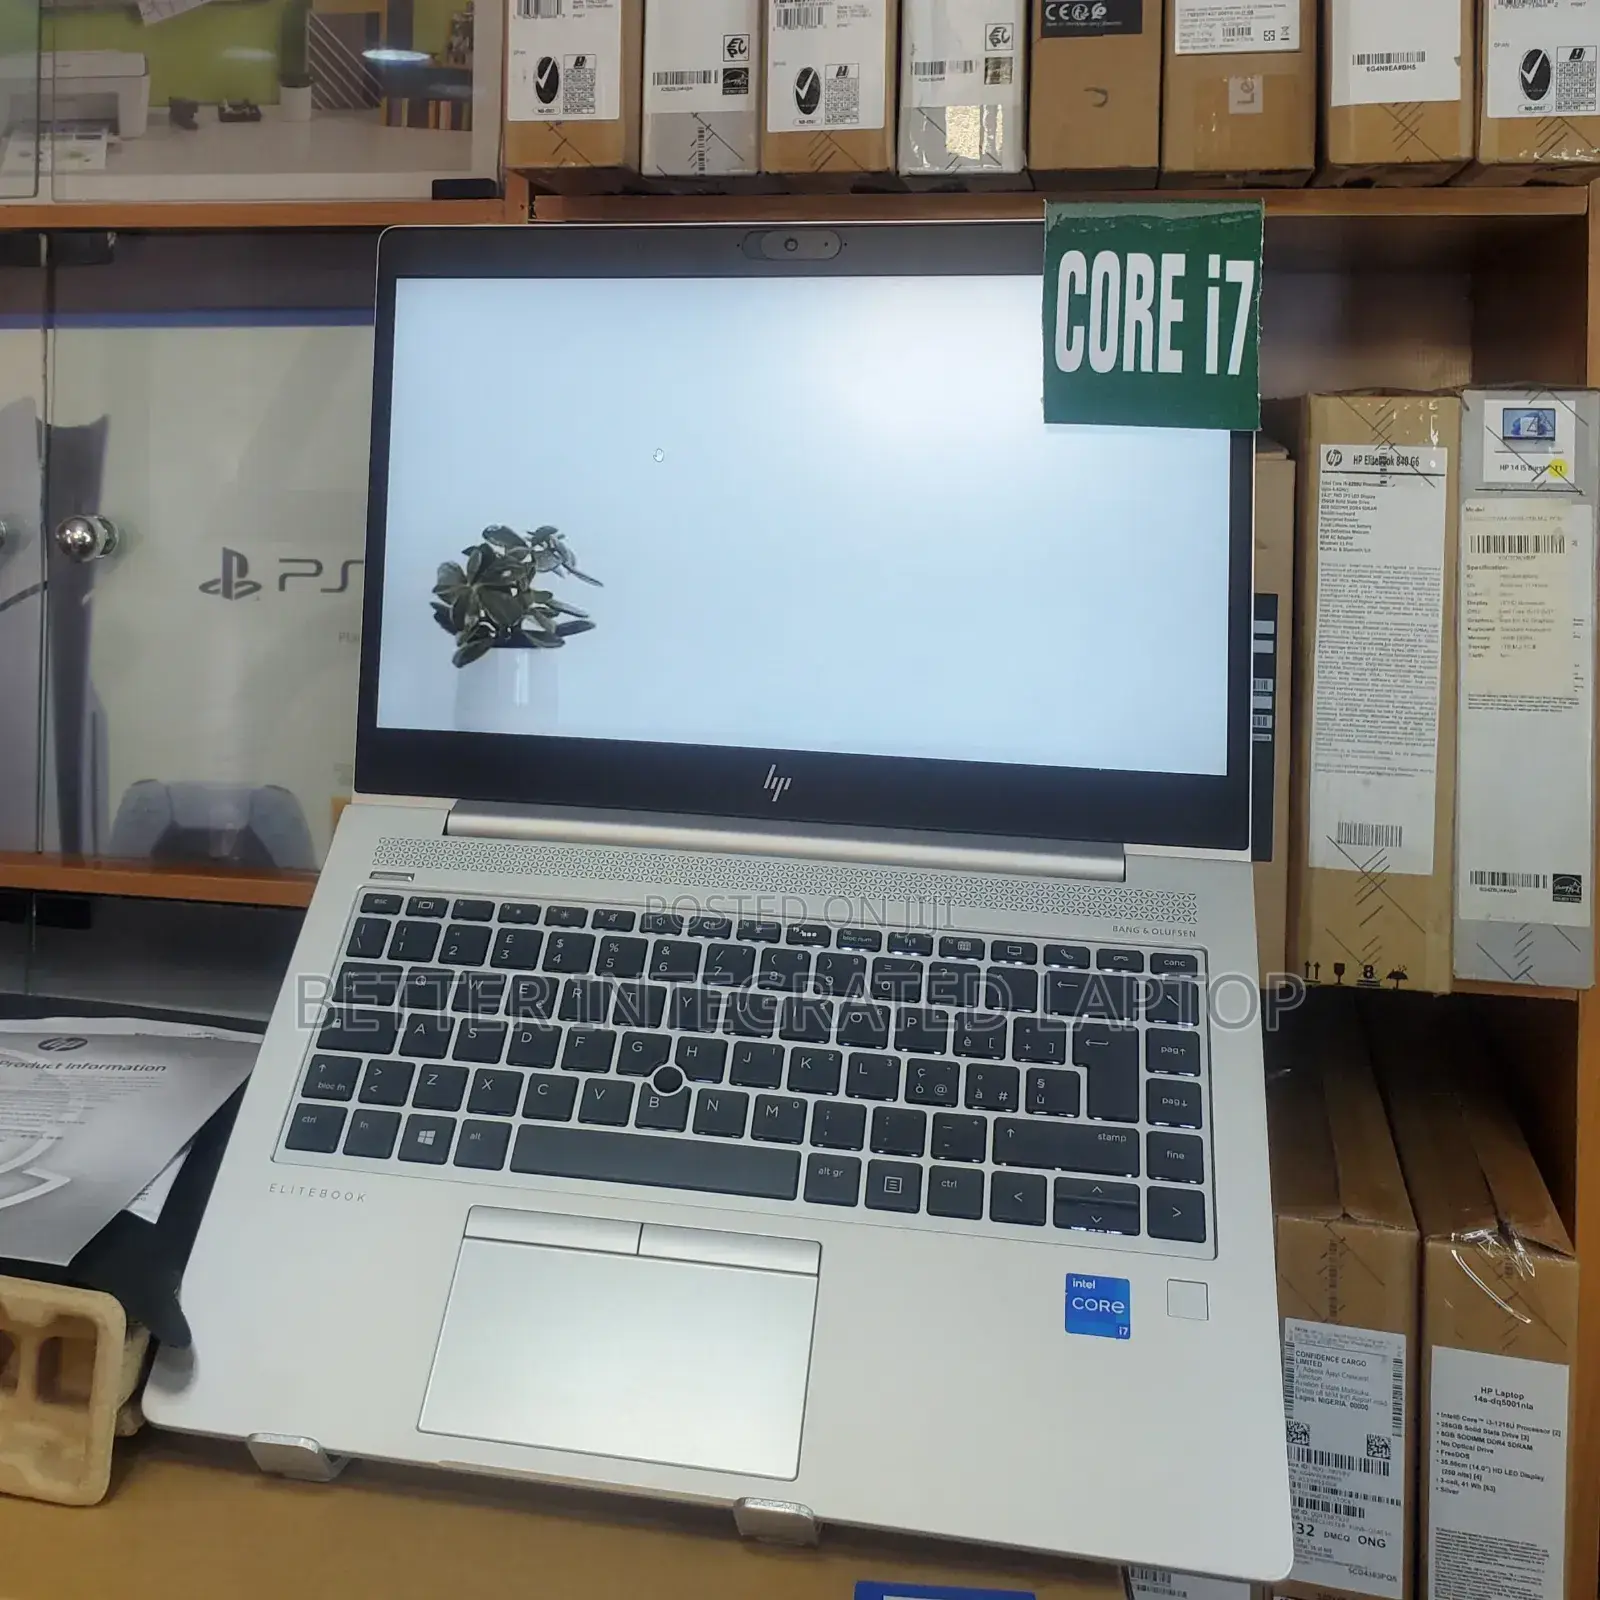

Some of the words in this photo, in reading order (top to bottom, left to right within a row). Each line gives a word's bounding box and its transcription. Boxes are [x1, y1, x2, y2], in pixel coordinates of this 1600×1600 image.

[1054, 250, 1186, 374] CORE
[1205, 254, 1255, 376] i7
[1353, 455, 1362, 465] HP
[1396, 456, 1409, 466] 840
[1410, 456, 1420, 467] G6
[278, 558, 364, 593] PS
[1112, 926, 1140, 934] BANG
[1152, 928, 1196, 938] OLUFSEN
[449, 946, 457, 955] 2
[610, 943, 618, 952] %
[662, 947, 670, 955] &
[501, 950, 509, 959] 3
[553, 954, 561, 963] 4
[606, 958, 614, 967] 5
[658, 962, 667, 973] 6
[712, 966, 722, 976] 7
[572, 988, 582, 998] R
[683, 997, 692, 1008] Y
[908, 1018, 917, 1028] P
[415, 1023, 425, 1035] A
[468, 1028, 477, 1038] S
[521, 1032, 532, 1042] D
[575, 1037, 585, 1046] F
[632, 1042, 642, 1052] G
[687, 1046, 697, 1056] H
[1161, 1046, 1178, 1056] pag
[743, 1052, 751, 1062] J
[0, 1059, 63, 1070] Product
[66, 1061, 167, 1073] Information
[801, 1057, 811, 1068] K
[860, 1063, 867, 1074] L
[427, 1074, 438, 1085] Z
[482, 1079, 493, 1090] X
[538, 1084, 548, 1095] C
[595, 1089, 605, 1099] V
[934, 1084, 947, 1095] @
[999, 1092, 1007, 1100] #
[649, 1097, 659, 1107] B
[707, 1099, 718, 1111] N
[1162, 1097, 1179, 1106] pag
[766, 1105, 778, 1117] M
[1098, 1133, 1126, 1142] stamp
[1167, 1151, 1184, 1159] fine
[819, 1167, 830, 1175] alt
[269, 1183, 367, 1202] ELITEBOOK
[1072, 1278, 1096, 1290] intel
[1119, 1327, 1128, 1336] i7
[1295, 1350, 1340, 1364] CONFIDENCE
[1341, 1358, 1367, 1367] CARGO
[1295, 1358, 1323, 1368] LIMITED
[1480, 1387, 1493, 1395] HP
[1495, 1389, 1525, 1400] Laptop
[1464, 1425, 1482, 1433] Solid
[1483, 1428, 1500, 1437] State
[1501, 1431, 1519, 1439] Drive
[1516, 1423, 1551, 1435] Processor
[1451, 1441, 1475, 1451] Optical
[1476, 1445, 1494, 1454] Drive
[1486, 1438, 1506, 1447] DDR4
[1507, 1441, 1534, 1451] SDRAM
[1440, 1449, 1470, 1460] FreeDOS
[1492, 1467, 1503, 1475] HD
[1504, 1469, 1518, 1477] LED
[1520, 1471, 1545, 1482] Display
[1440, 1486, 1460, 1495] Silver
[1471, 1482, 1482, 1490] Wh
[1292, 1522, 1315, 1537] 32
[1357, 1535, 1386, 1549] ONG
